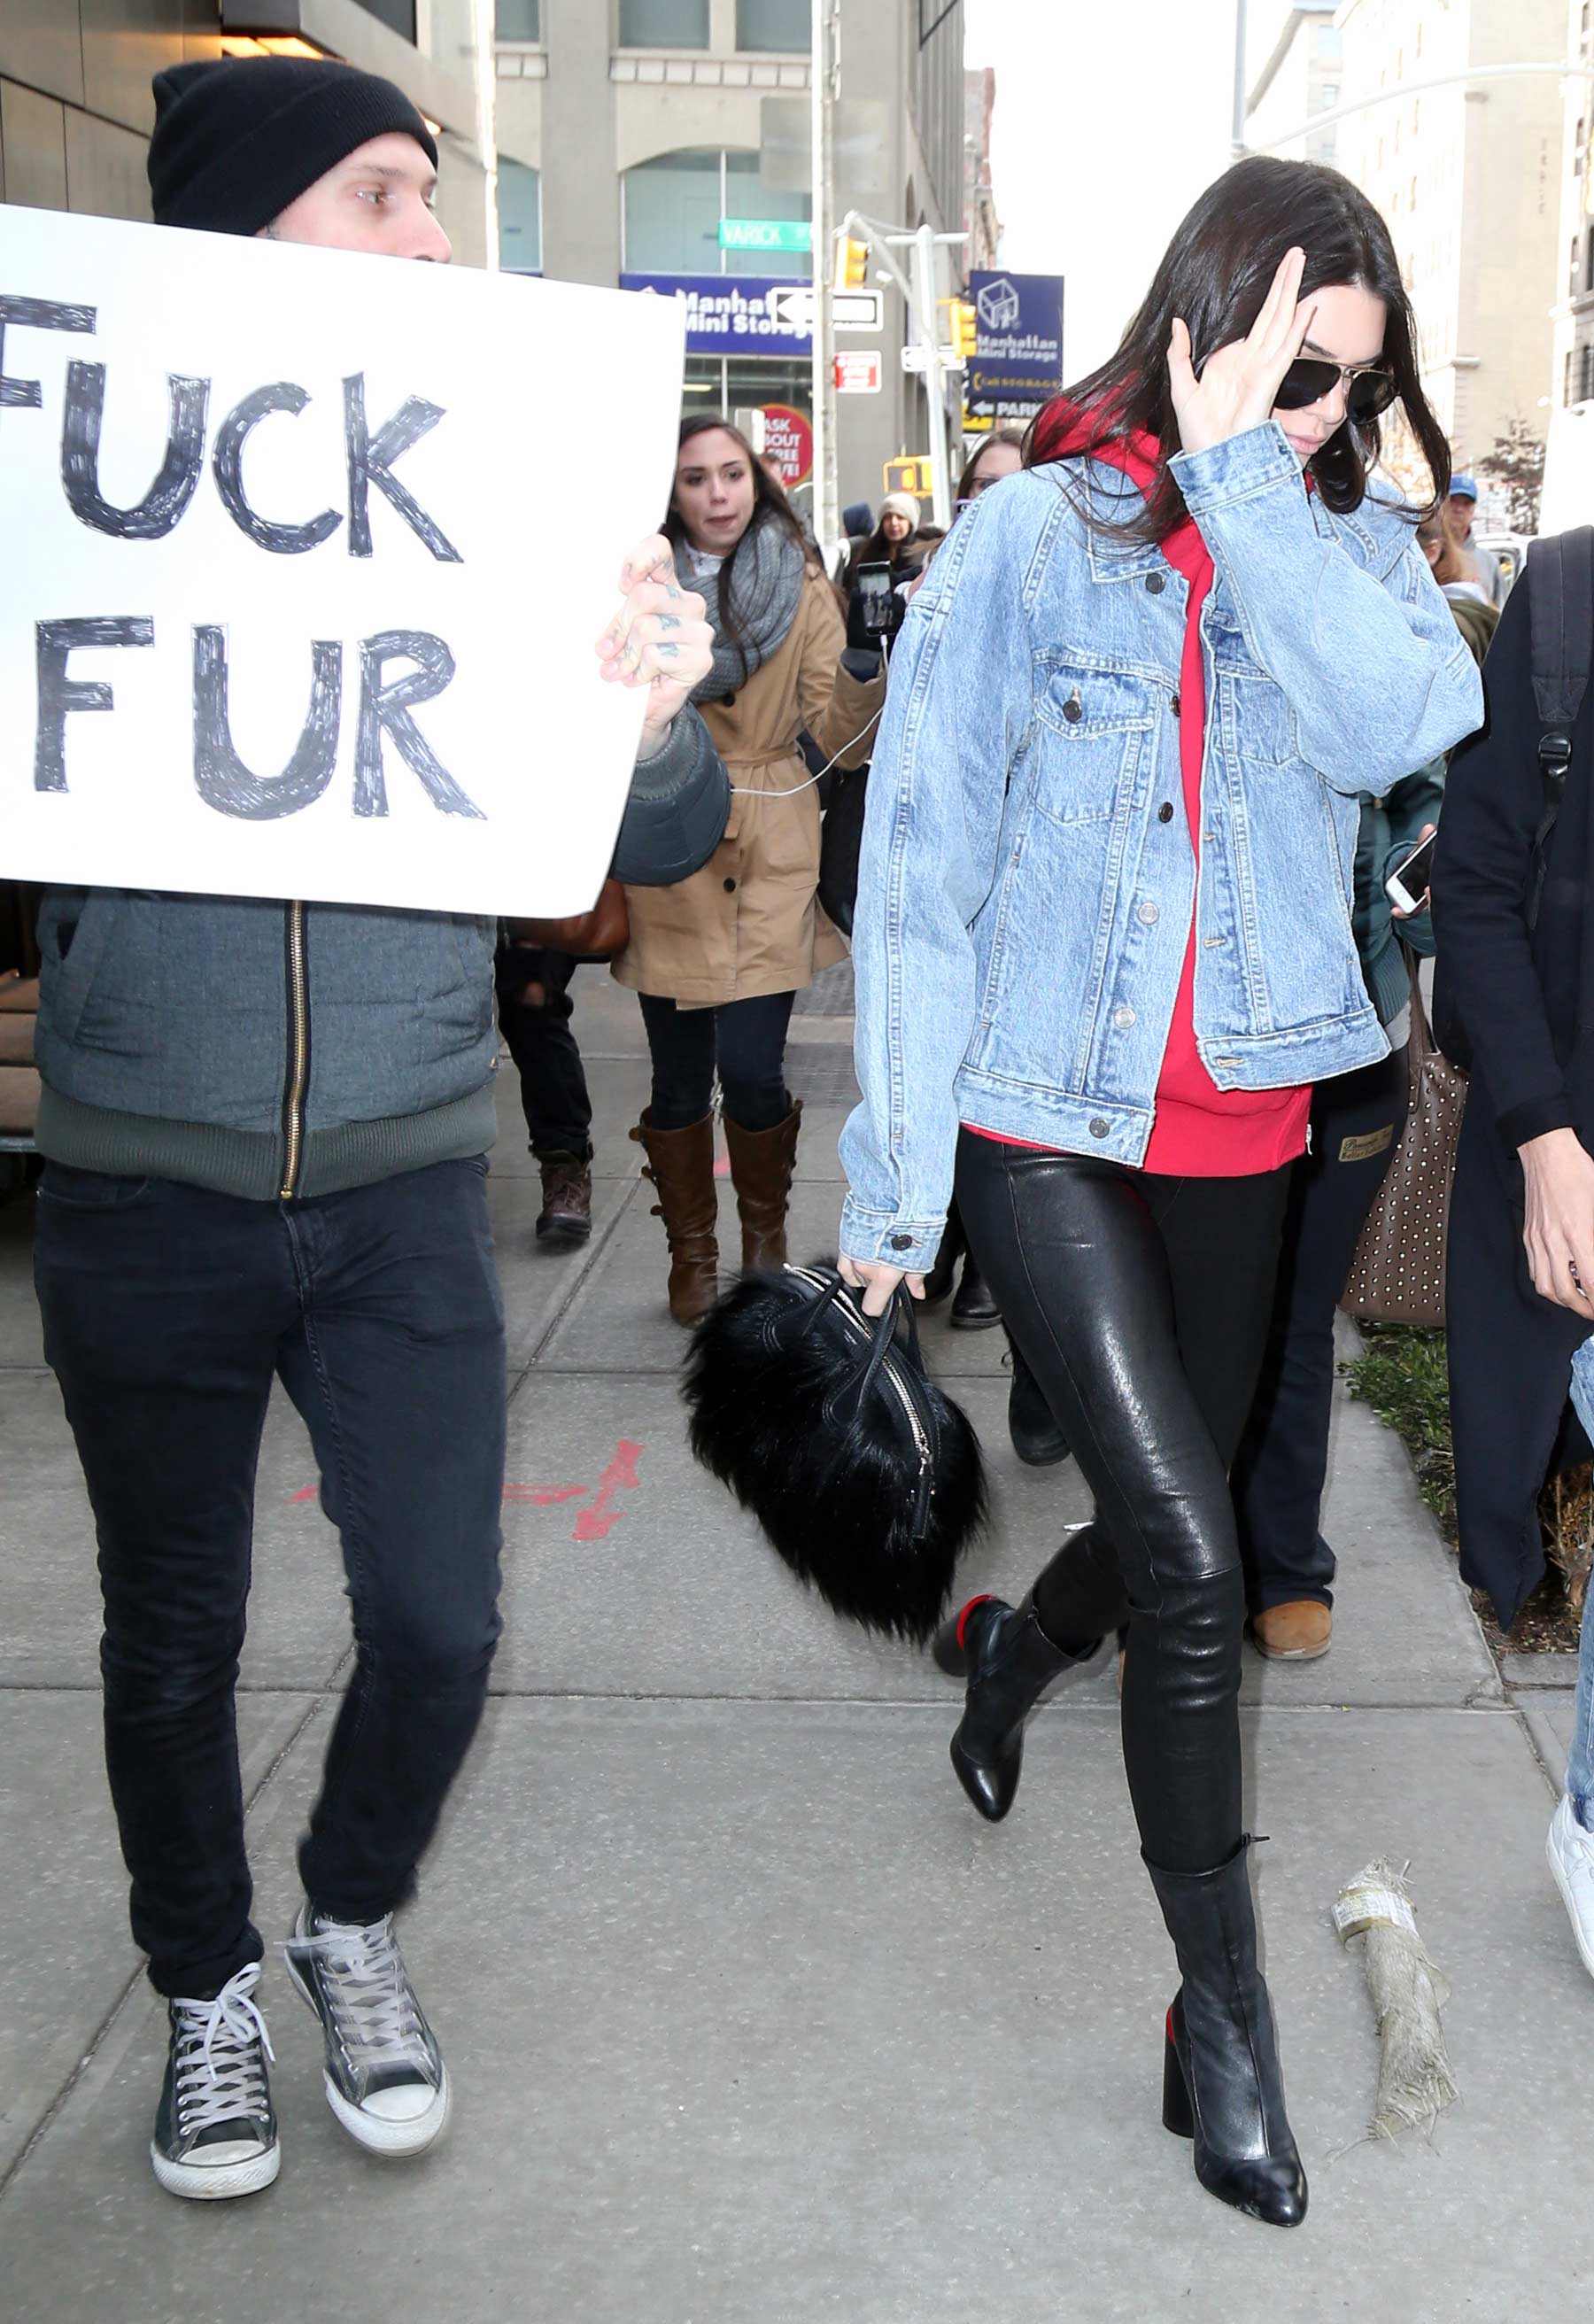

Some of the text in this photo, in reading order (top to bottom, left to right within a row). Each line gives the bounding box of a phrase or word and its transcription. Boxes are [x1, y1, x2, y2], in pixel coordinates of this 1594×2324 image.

[978, 336, 1057, 351] Manhattan
[1009, 349, 1057, 362] Storage
[0, 294, 464, 563] FUCK
[34, 615, 488, 821] FUR
